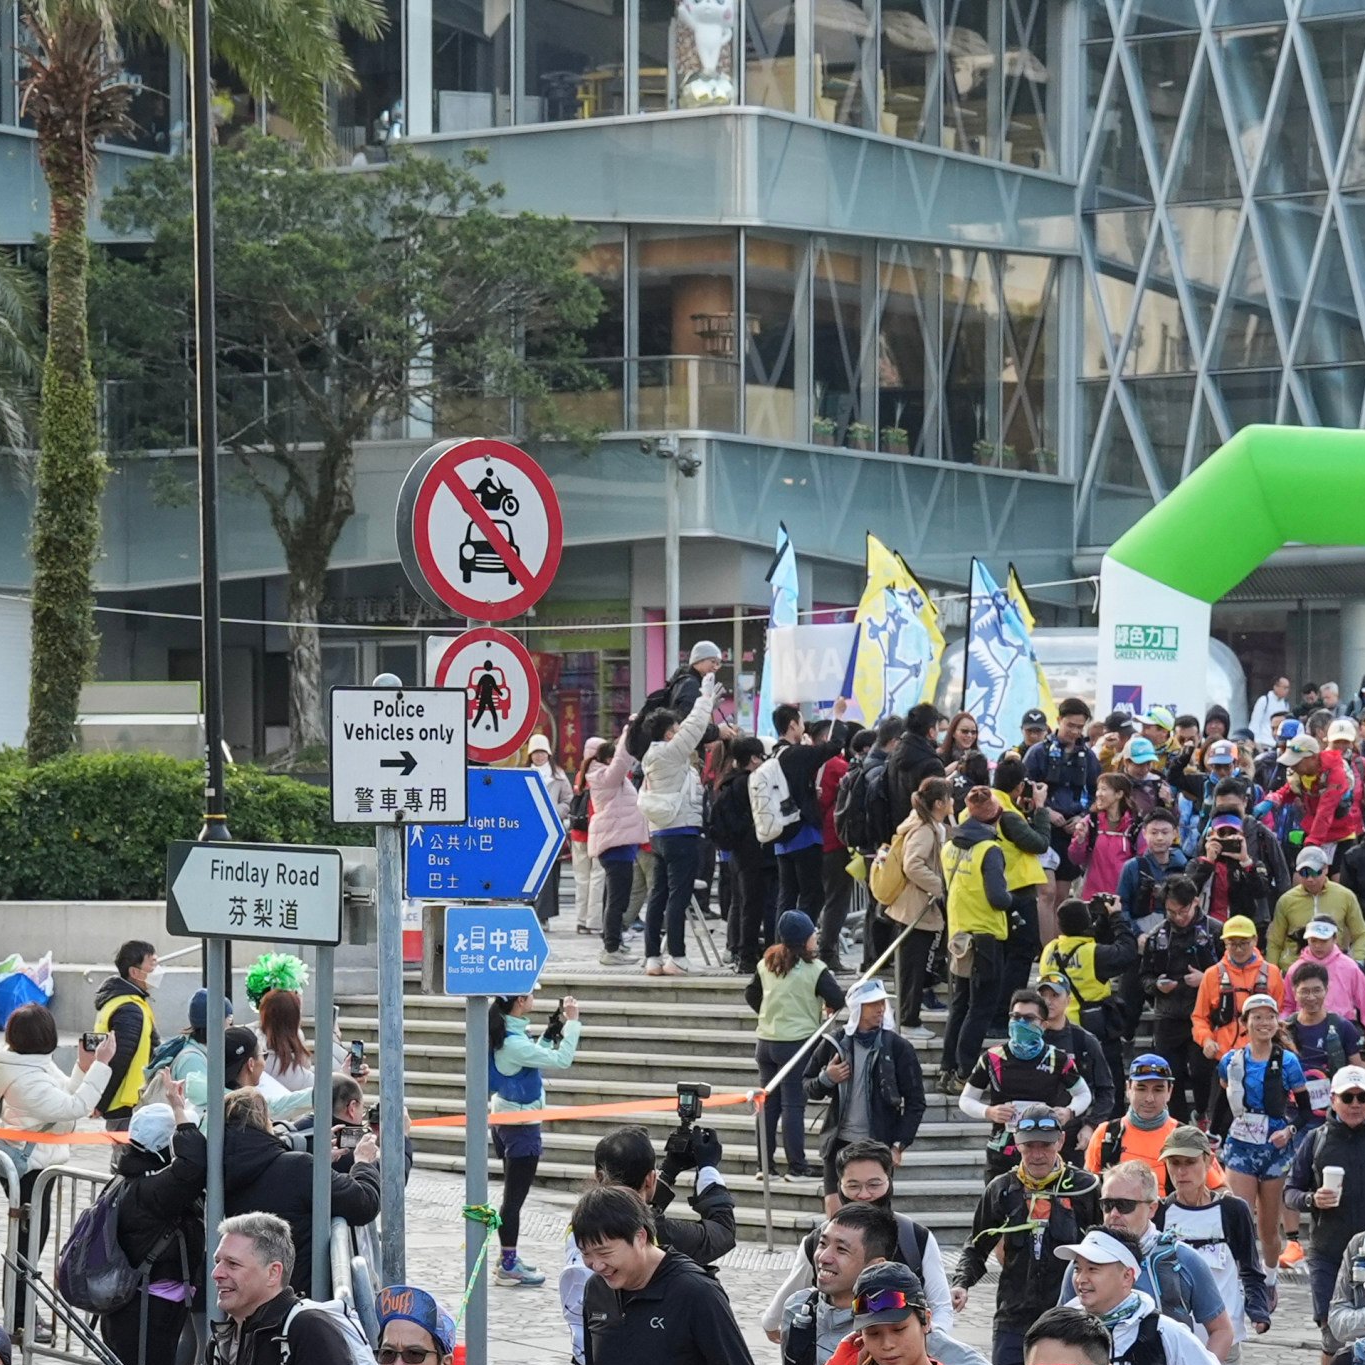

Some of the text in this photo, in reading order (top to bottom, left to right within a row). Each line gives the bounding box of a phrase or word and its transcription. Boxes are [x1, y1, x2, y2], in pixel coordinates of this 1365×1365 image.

[1115, 650, 1177, 661] GREEN POWER
[373, 700, 425, 718] Police
[344, 723, 455, 744] Vehicles only
[355, 787, 448, 813] 警車專用
[468, 816, 496, 829] Light
[498, 817, 520, 830] Bus
[429, 834, 494, 852] 公共小巴
[428, 854, 451, 867] Bus
[211, 859, 320, 888] Findlay Road
[428, 872, 460, 890] 巴士
[228, 897, 299, 931] 芬梨道
[489, 928, 529, 953] 中環
[460, 966, 475, 974] Stop
[488, 954, 538, 972] Central
